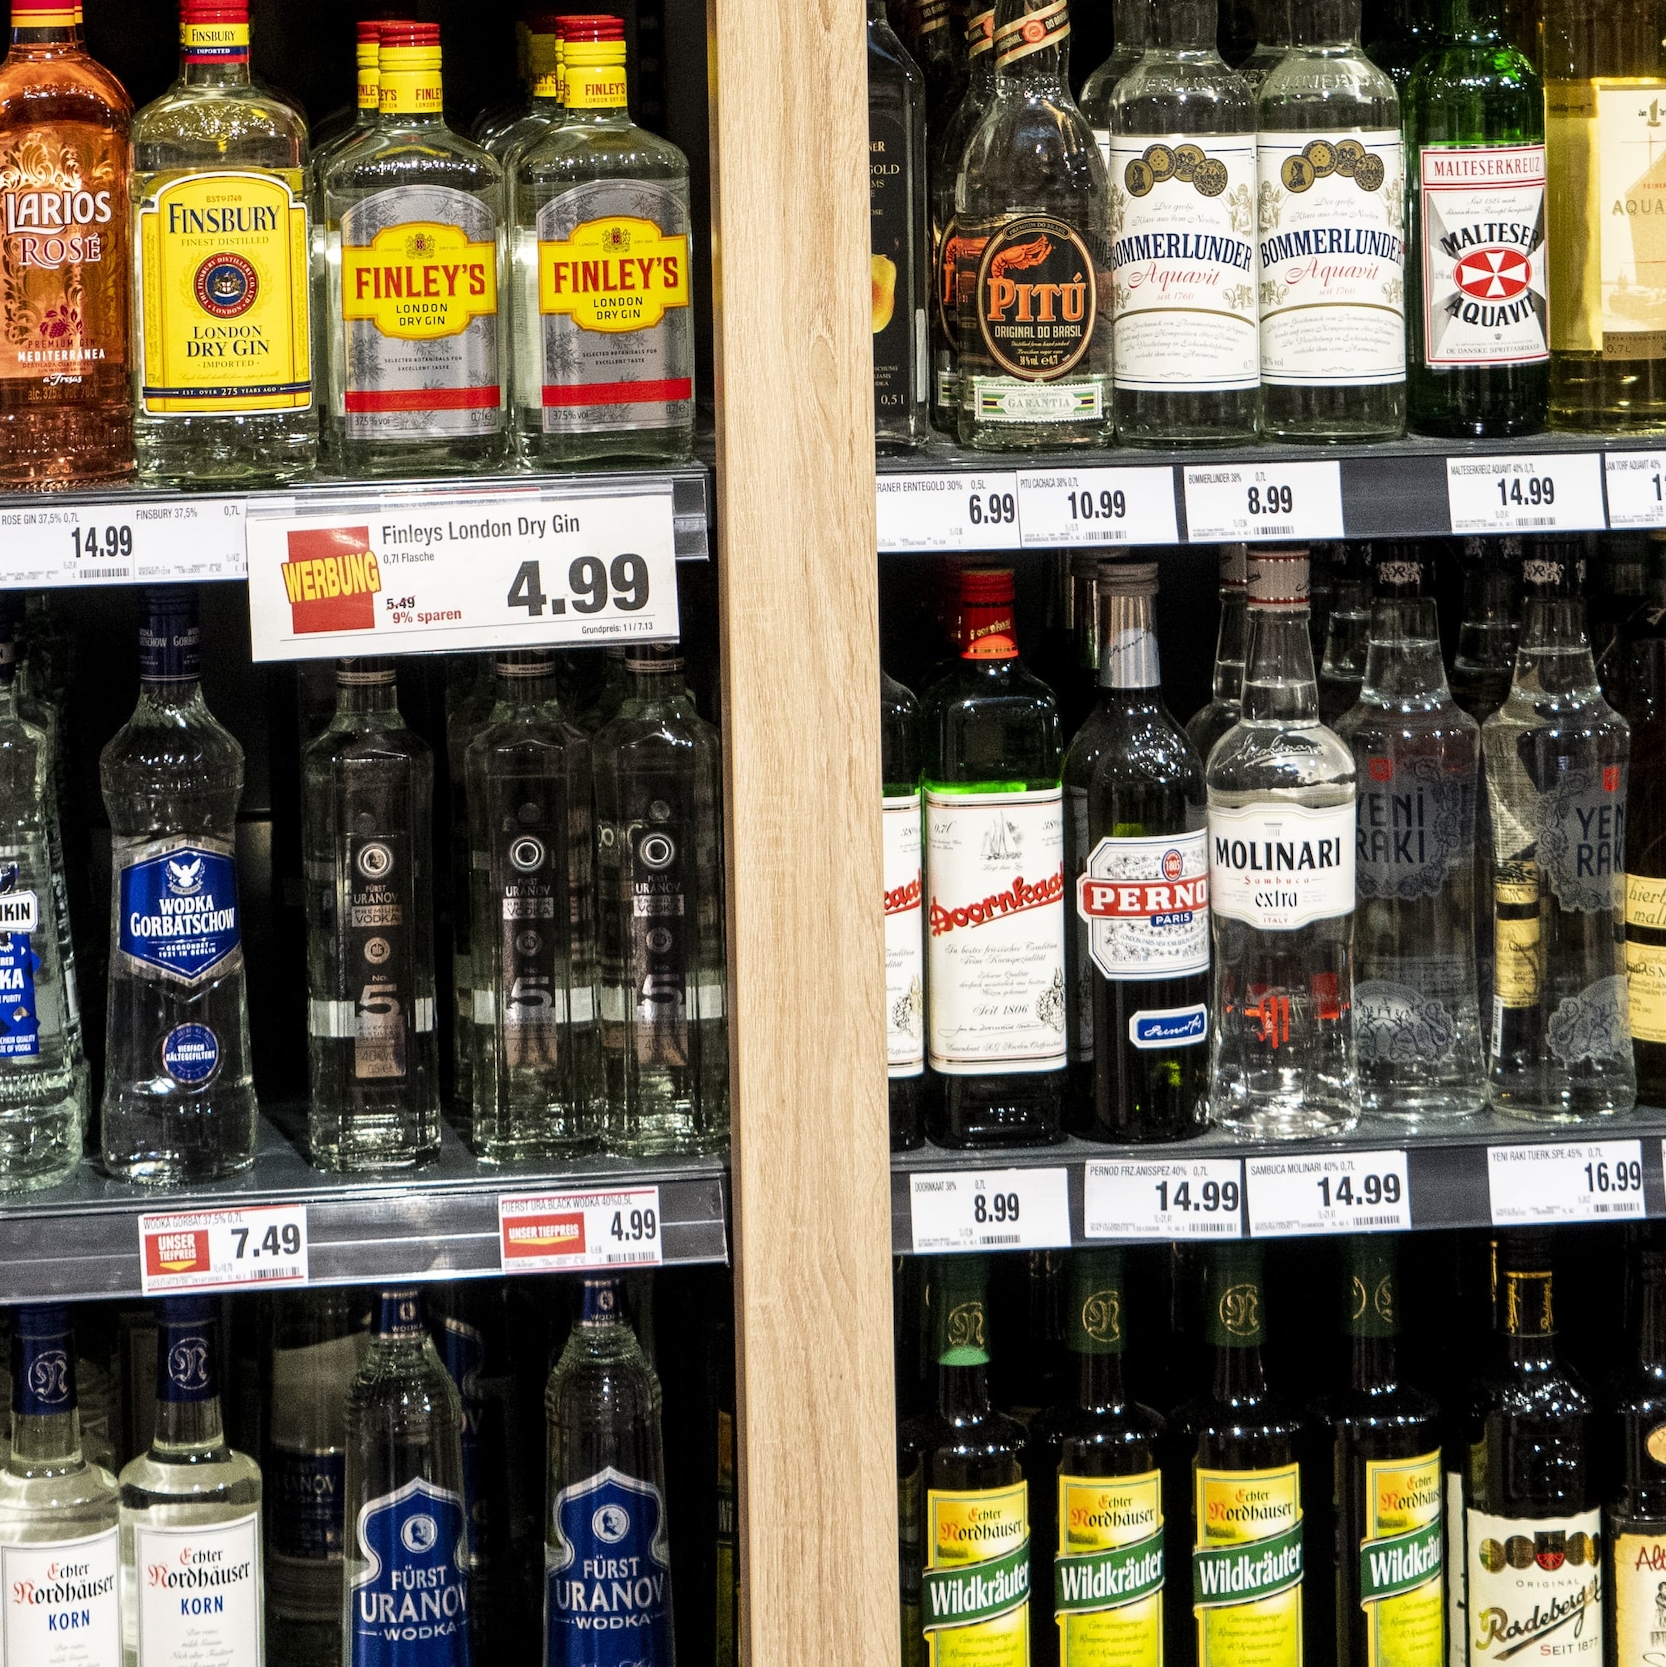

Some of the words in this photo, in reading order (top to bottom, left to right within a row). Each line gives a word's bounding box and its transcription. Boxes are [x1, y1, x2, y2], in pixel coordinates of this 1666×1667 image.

[1434, 157, 1541, 176] MALTESERKREUZ
[7, 191, 111, 233] LARIOS
[168, 201, 279, 234] FINSBURY
[19, 233, 101, 269] ROSÉ
[1440, 223, 1538, 256] MALTESER
[355, 263, 485, 298] FINLEY'S
[553, 256, 677, 292] FINLEY'S
[396, 303, 447, 313] LONDON
[987, 275, 1086, 322] PITÚ
[1445, 293, 1536, 327] AQUAVIT
[193, 326, 262, 339] LONDON
[186, 341, 225, 356] DRY
[233, 340, 269, 356] GIN
[969, 494, 1014, 524] 6.99
[1068, 490, 1126, 519] 10.99
[1248, 485, 1293, 514] 8.99
[383, 524, 443, 546] Finleys
[449, 519, 511, 540] London
[518, 516, 546, 538] Dry
[553, 514, 580, 533] Gin
[402, 552, 434, 563] Flasche
[281, 549, 381, 603] WERBUNG
[507, 553, 649, 617] 4.99
[386, 596, 415, 611] 5.49
[393, 612, 412, 624] 9%
[418, 609, 461, 625] sparen
[1215, 837, 1341, 870] MOLINARI
[159, 896, 214, 917] WODKA
[1254, 889, 1297, 910] extra
[131, 911, 235, 938] GORBATSCHOW
[1156, 912, 1190, 926] PARIS
[1318, 1172, 1401, 1207] 14.99
[1584, 1160, 1642, 1193] 16.99
[974, 1193, 1020, 1223] 8.99
[1156, 1181, 1238, 1212] 14.99
[611, 1211, 656, 1241] 4.99
[231, 1225, 301, 1259] 7.49
[584, 1555, 639, 1579] FÜRST
[1200, 1542, 1301, 1595] Wildkräuter
[556, 1574, 664, 1613] URANOV
[49, 1611, 90, 1631] KORN
[576, 1614, 651, 1630] WODKA
